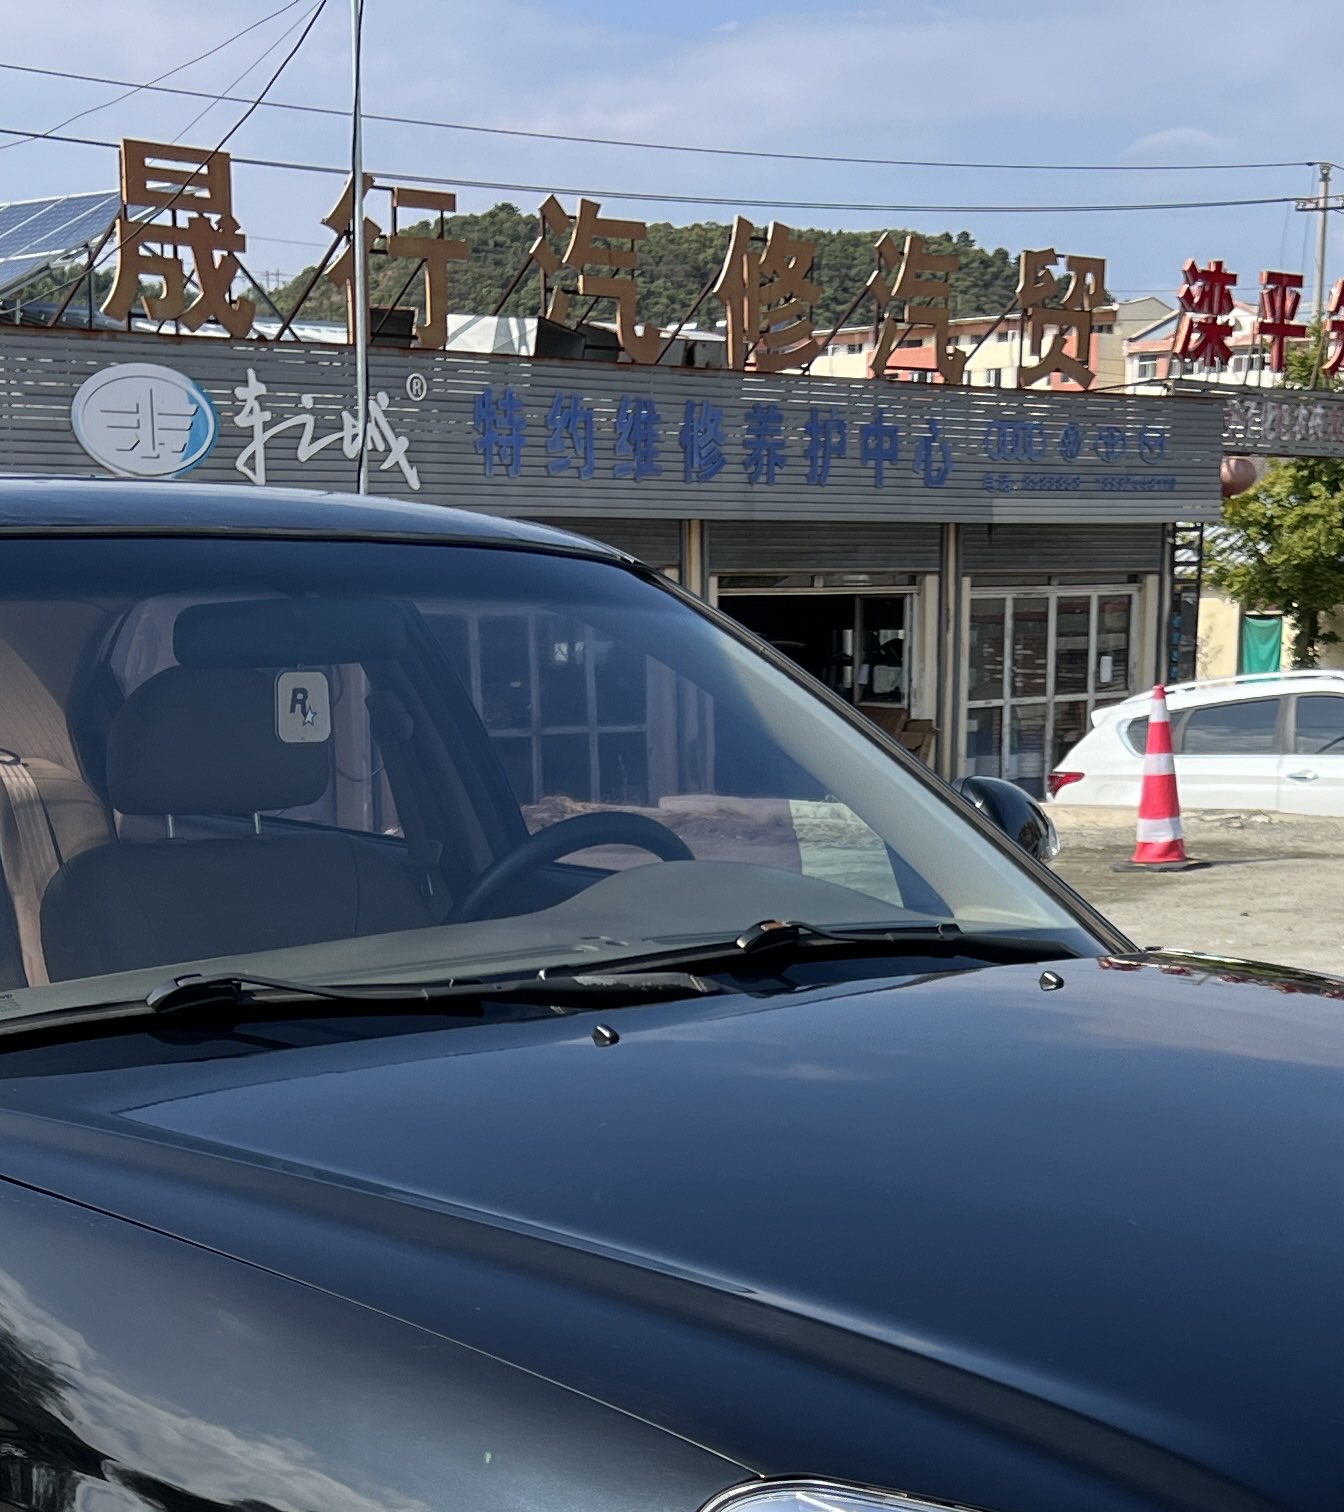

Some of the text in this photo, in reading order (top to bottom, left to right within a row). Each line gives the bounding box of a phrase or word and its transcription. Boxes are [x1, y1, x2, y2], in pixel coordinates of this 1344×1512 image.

[101, 138, 1106, 392] 晟行汽修汽贸
[474, 388, 954, 488] 特约维修养护中心
